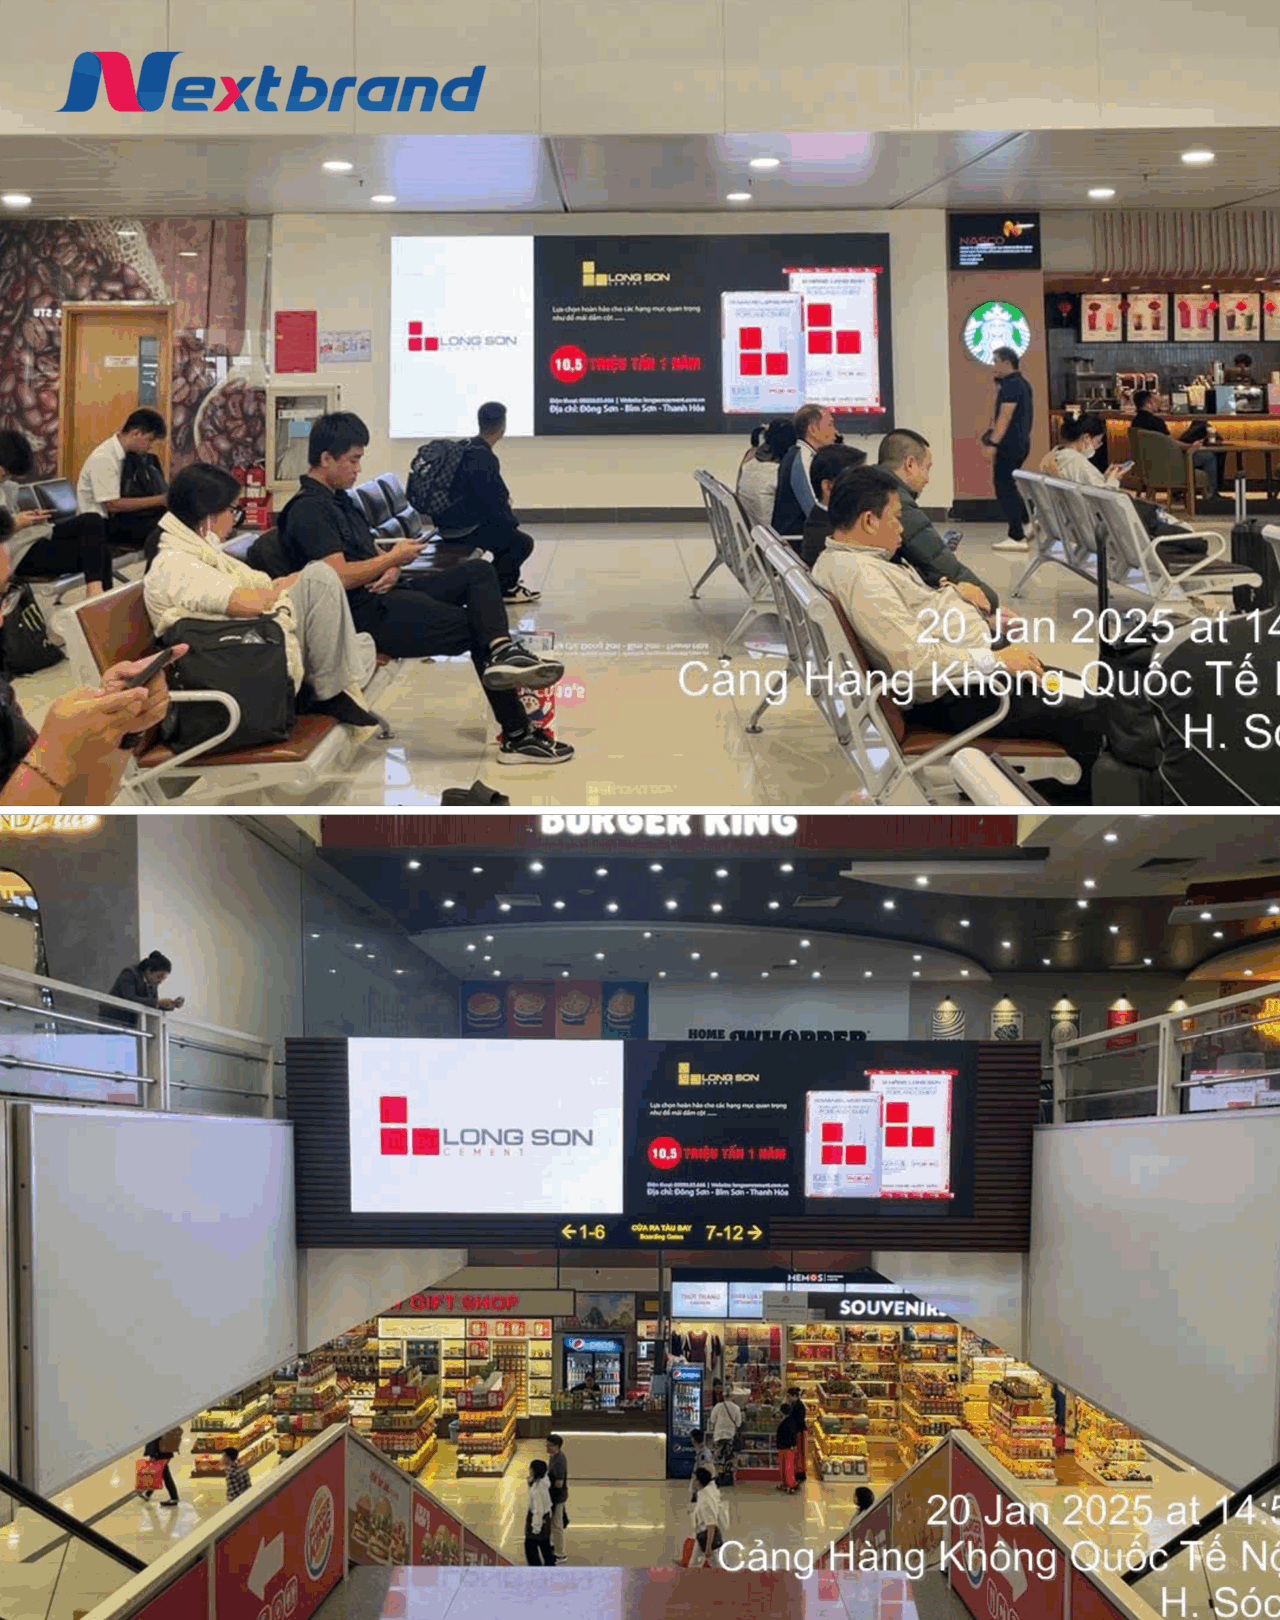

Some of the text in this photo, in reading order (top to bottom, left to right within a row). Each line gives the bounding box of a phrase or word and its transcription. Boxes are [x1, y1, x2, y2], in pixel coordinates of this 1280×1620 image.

[608, 273, 670, 282] LONG SON
[440, 336, 517, 346] LONG SON
[541, 815, 798, 836] BURGER KING
[688, 1029, 725, 1040] HOME
[702, 1074, 760, 1082] LONG SON
[443, 1128, 594, 1146] LONG SON
[443, 1148, 524, 1156] CEMENT
[750, 1188, 774, 1196] Thanh
[579, 1224, 606, 1240] 1-6
[649, 1224, 661, 1232] RA
[677, 1224, 693, 1232] BAY
[706, 1225, 743, 1240] 7-12
[409, 1293, 454, 1311] GIFT
[461, 1293, 519, 1311] SHOP
